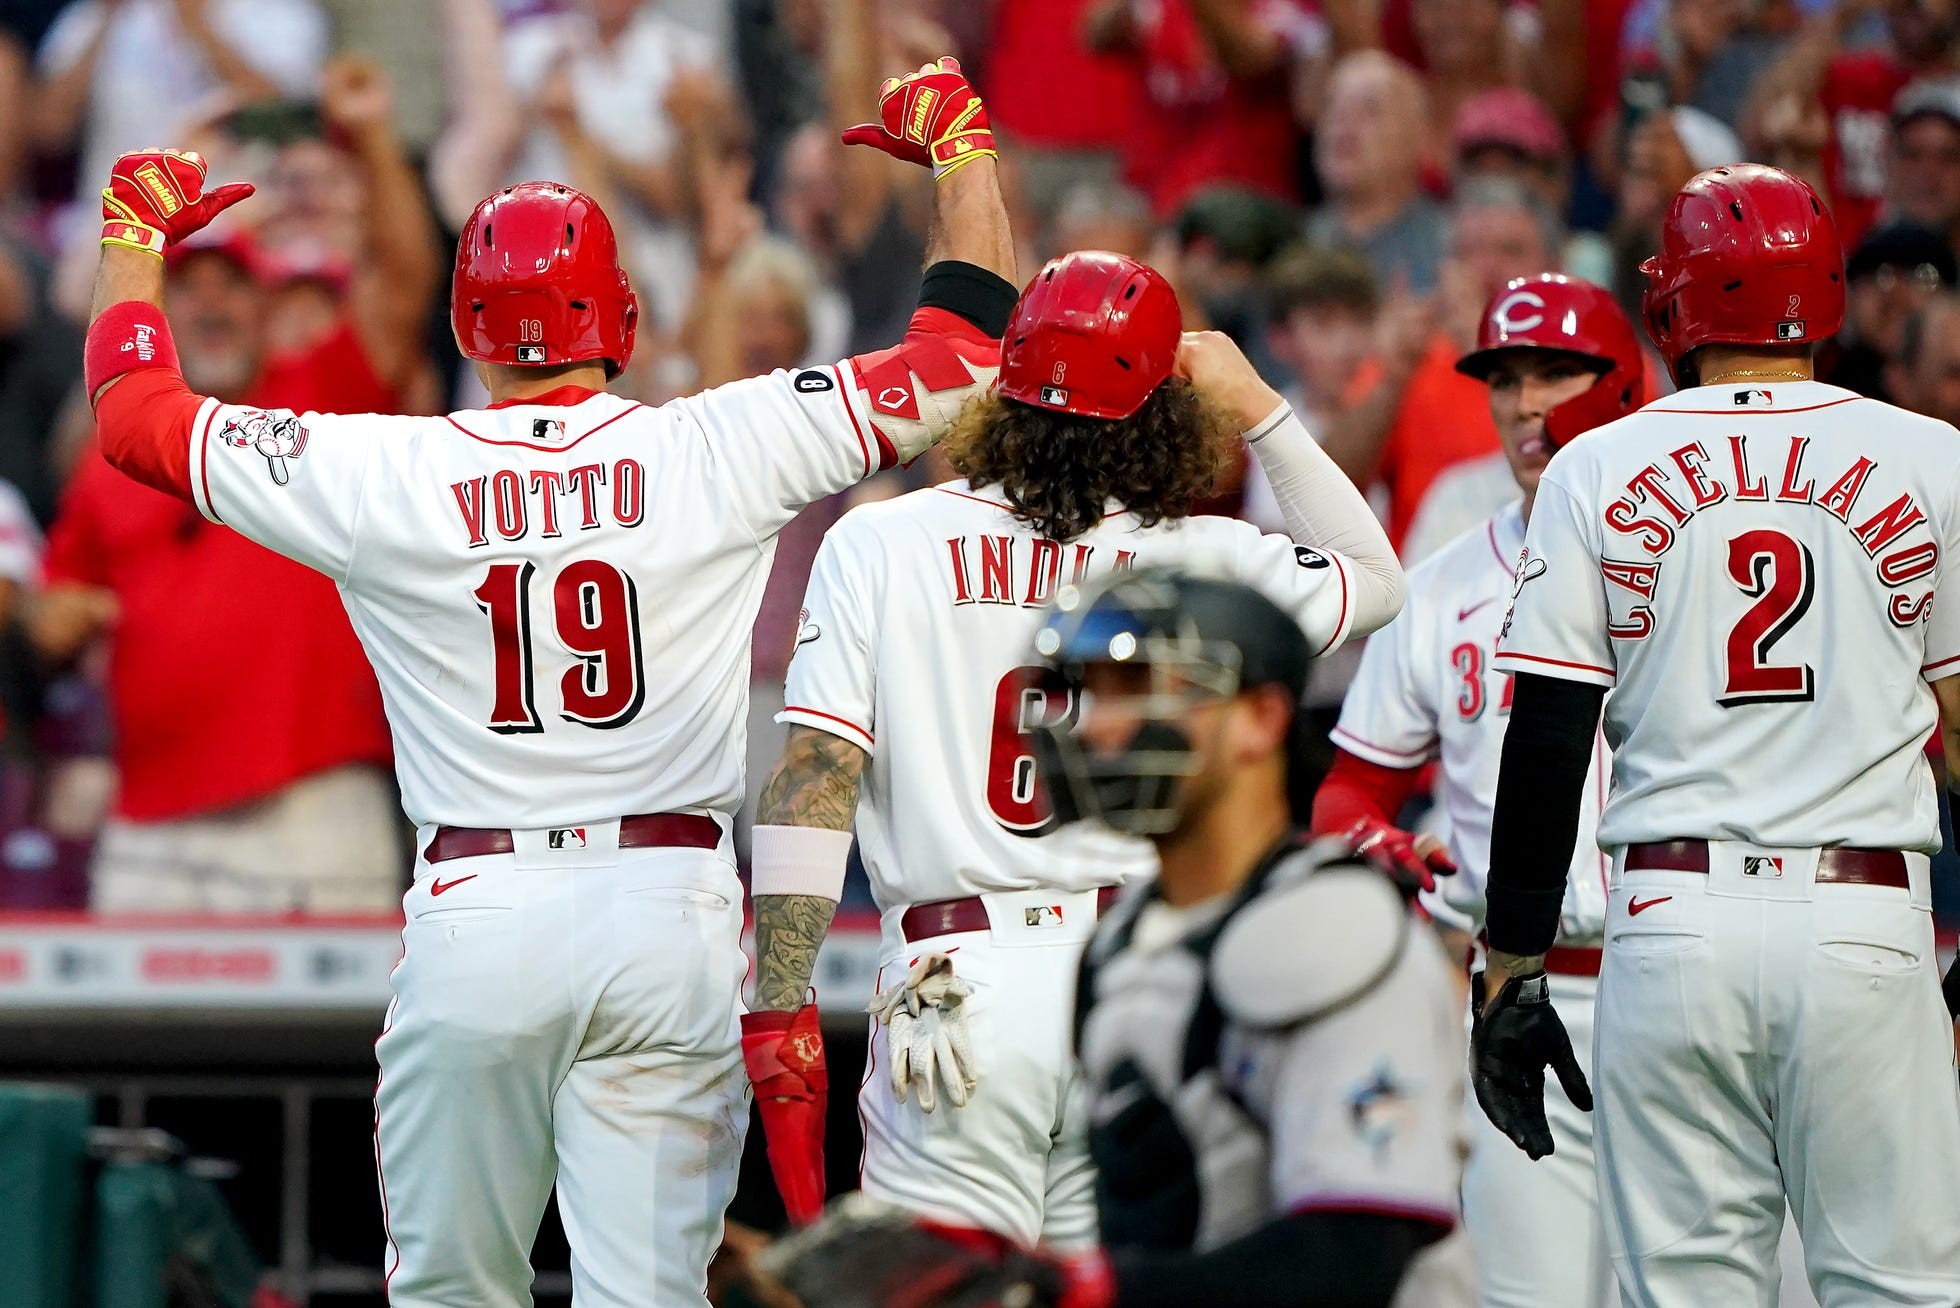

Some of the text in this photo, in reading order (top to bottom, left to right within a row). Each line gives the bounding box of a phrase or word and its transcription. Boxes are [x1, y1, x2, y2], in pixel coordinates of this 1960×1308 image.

[908, 89, 935, 143] Franklin
[136, 167, 177, 213] Franklin
[519, 318, 543, 342] 19
[1492, 291, 1546, 332] C
[1785, 294, 1801, 318] 2
[133, 323, 157, 361] Franklin
[1052, 360, 1067, 385] 6
[450, 458, 645, 548] VOTTO
[1600, 434, 1938, 641] CASTELLANOS
[1716, 528, 1815, 709] 2
[471, 558, 646, 735] 19
[1450, 640, 1515, 722] 3
[982, 664, 1082, 838] 6
